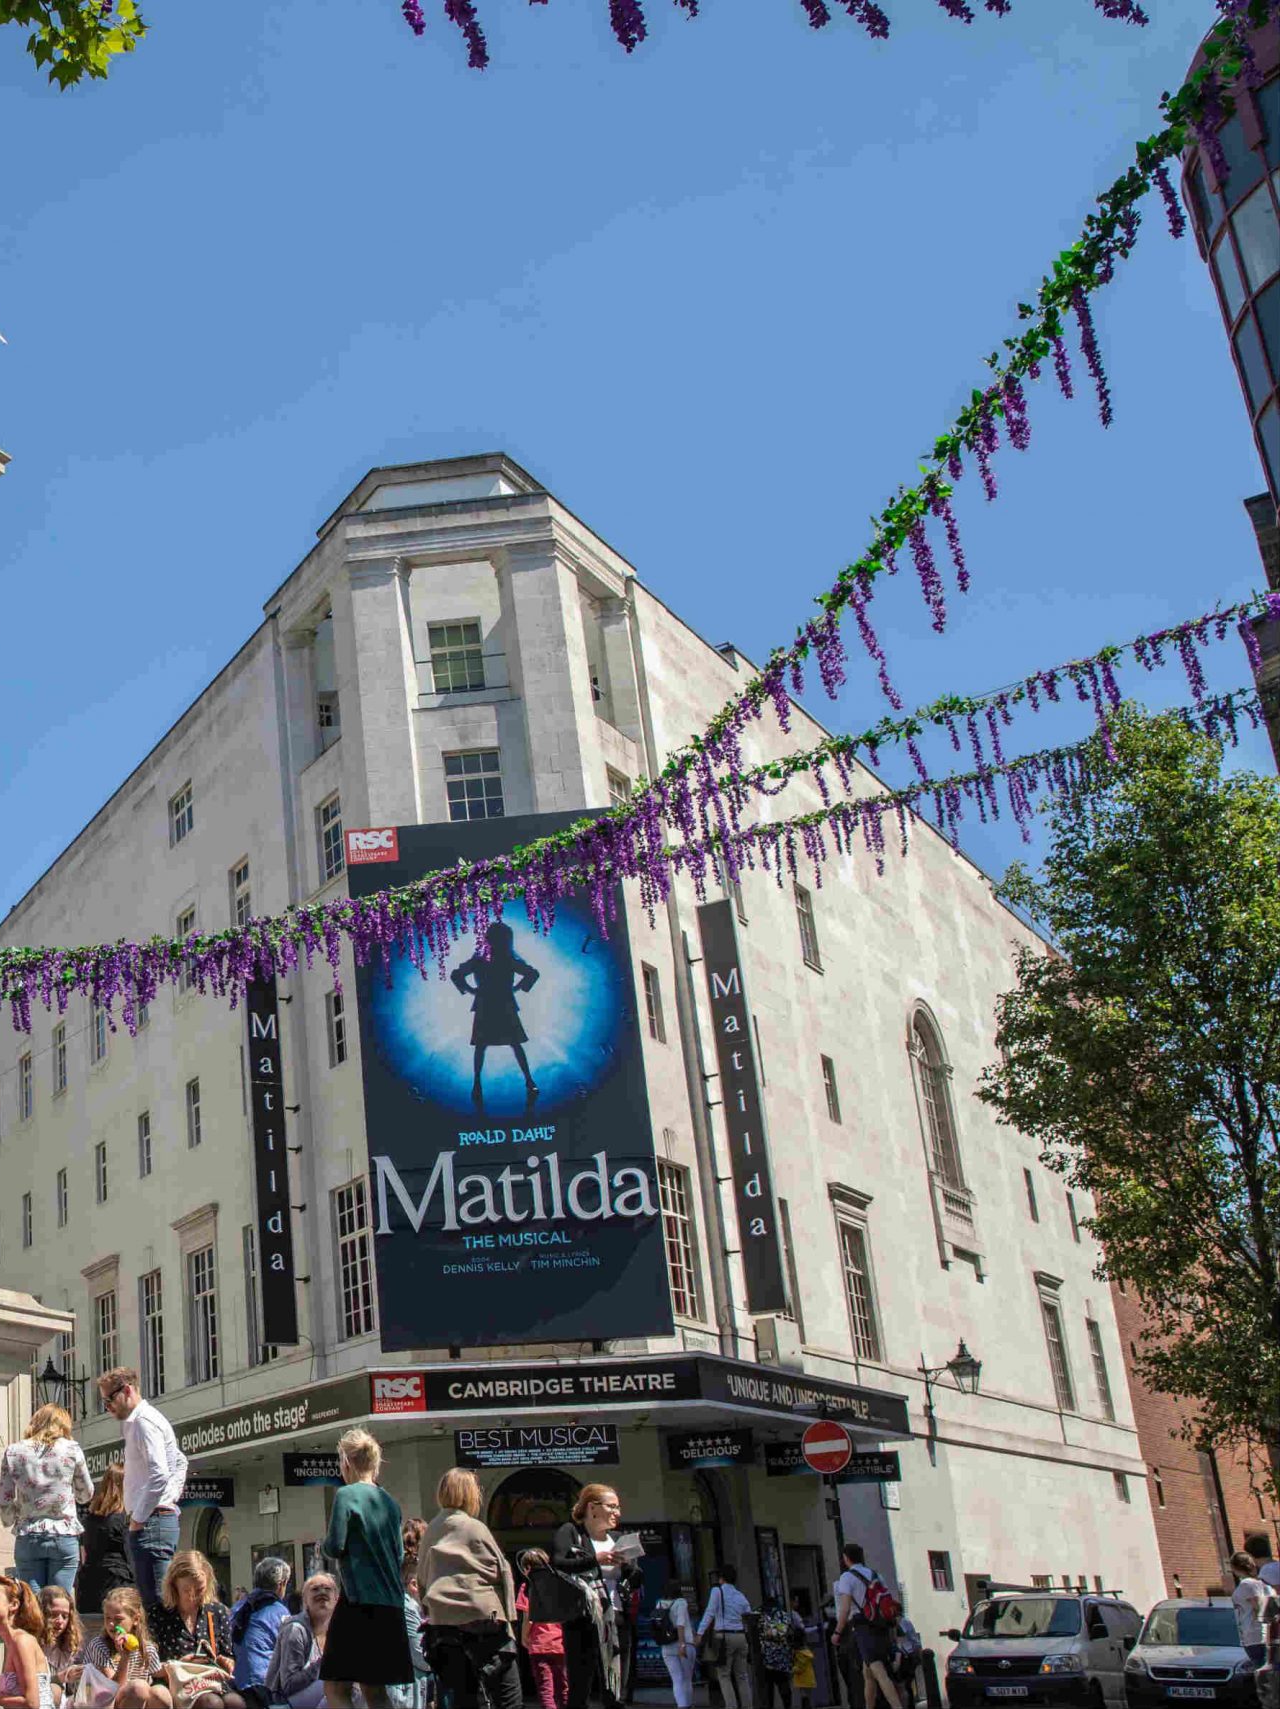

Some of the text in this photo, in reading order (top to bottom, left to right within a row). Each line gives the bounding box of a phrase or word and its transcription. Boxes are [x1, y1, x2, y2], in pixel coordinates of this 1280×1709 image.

[349, 830, 393, 849] RSC
[711, 968, 767, 1236] Matilda
[251, 1012, 286, 1271] Matilda
[459, 1130, 505, 1146] ROALD
[372, 1151, 658, 1235] Matilda
[463, 1231, 571, 1249] THE MUSICAL
[443, 1261, 519, 1274] DENNIS KELLY
[530, 1257, 600, 1269] TIM MINCHIN
[375, 1377, 421, 1398] RSC
[448, 1373, 676, 1399] CAMBRIDGE THEATRE
[772, 1383, 793, 1406] AND
[182, 1426, 225, 1451] explodes
[227, 1416, 251, 1441] onto
[253, 1411, 272, 1433] the
[460, 1427, 616, 1449] BEST MUSICAL
[680, 1445, 741, 1459] 'DELICIOUS'
[294, 1467, 343, 1478] 'INGENIOU
